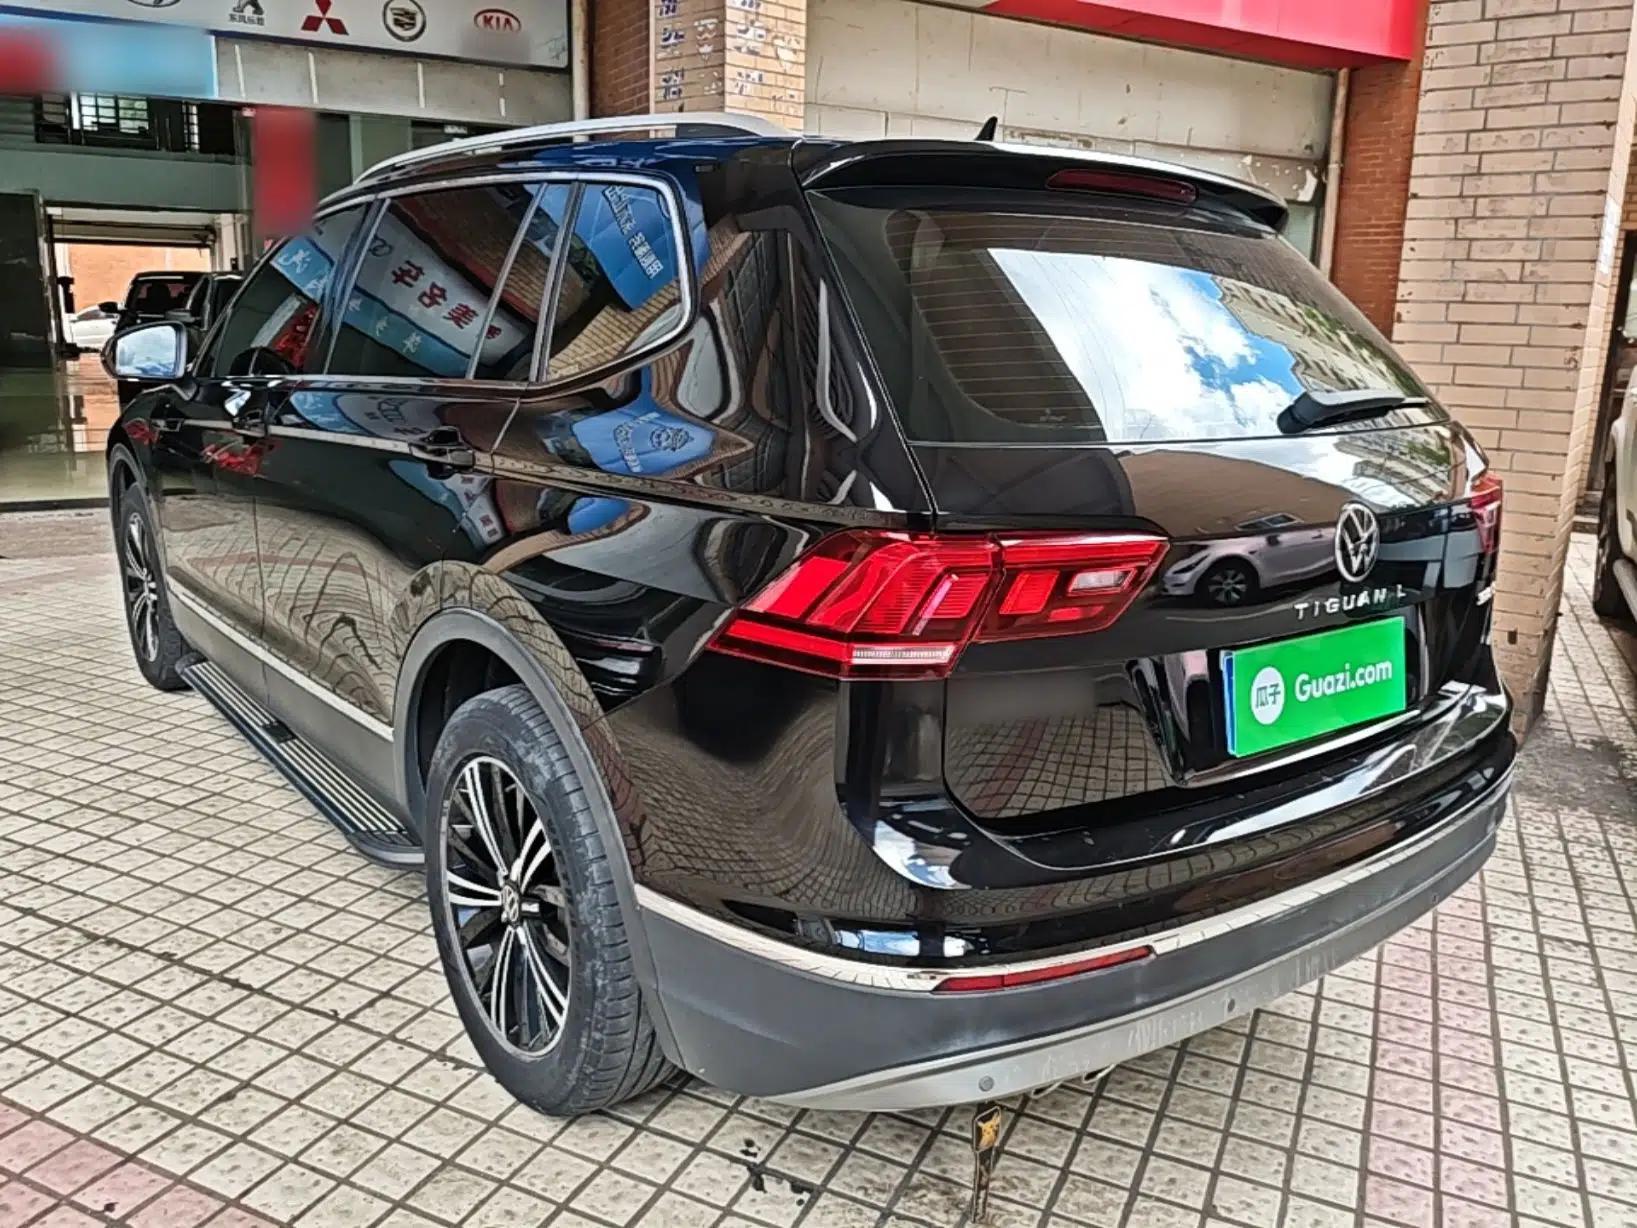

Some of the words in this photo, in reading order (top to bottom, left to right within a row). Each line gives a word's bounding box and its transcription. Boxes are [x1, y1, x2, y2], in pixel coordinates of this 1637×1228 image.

[483, 15, 513, 31] KIA
[1294, 588, 1387, 620] TIGUAN
[1396, 584, 1407, 598] L
[1255, 683, 1282, 709] 瓜子
[1295, 660, 1393, 702] Guazi.com
